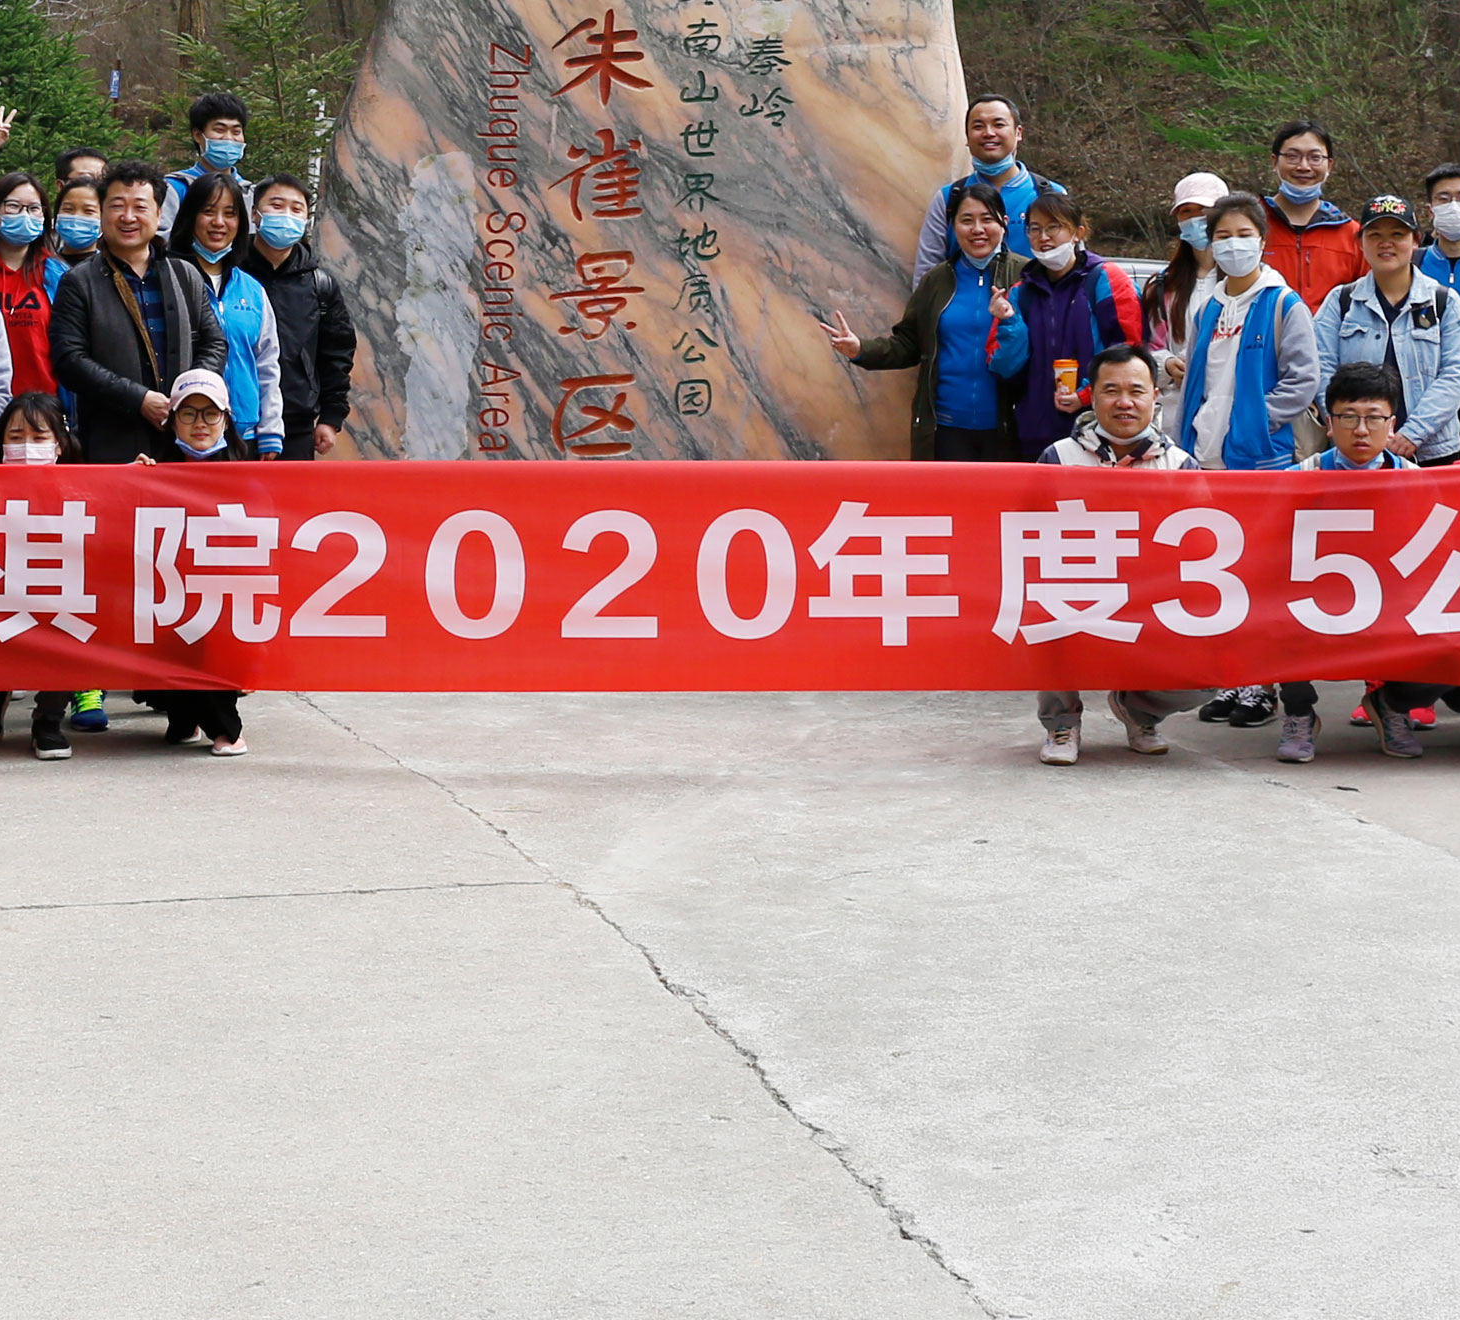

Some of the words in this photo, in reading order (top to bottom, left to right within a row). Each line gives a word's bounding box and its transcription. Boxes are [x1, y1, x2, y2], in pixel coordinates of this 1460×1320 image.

[477, 42, 531, 188] Zhuque
[482, 211, 527, 342] Scenic
[548, 7, 654, 457] 朱雀景区
[477, 361, 522, 453] Area
